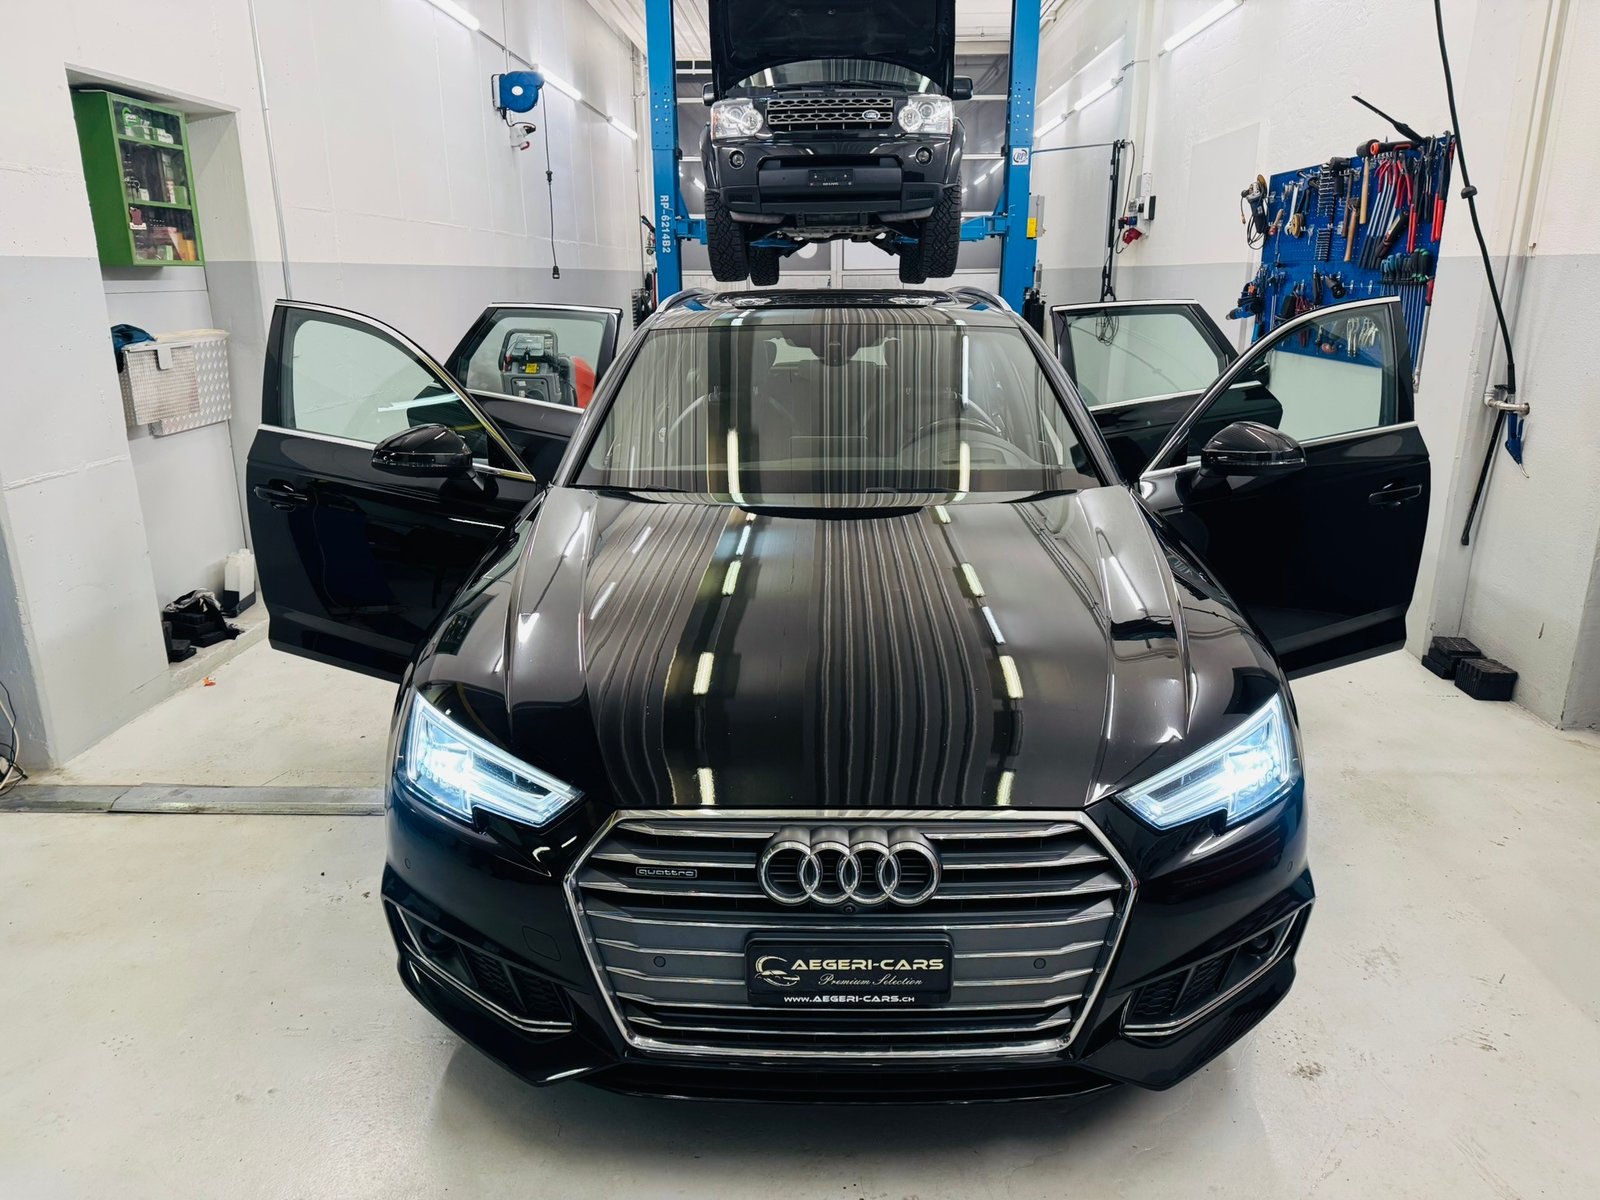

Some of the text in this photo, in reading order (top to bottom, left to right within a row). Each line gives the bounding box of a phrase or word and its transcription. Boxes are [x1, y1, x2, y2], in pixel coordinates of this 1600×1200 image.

[660, 195, 671, 253] RP-6214B2
[638, 868, 695, 877] quattro
[791, 958, 944, 971] AEGERI-CARS
[818, 973, 923, 986] Premium Selection
